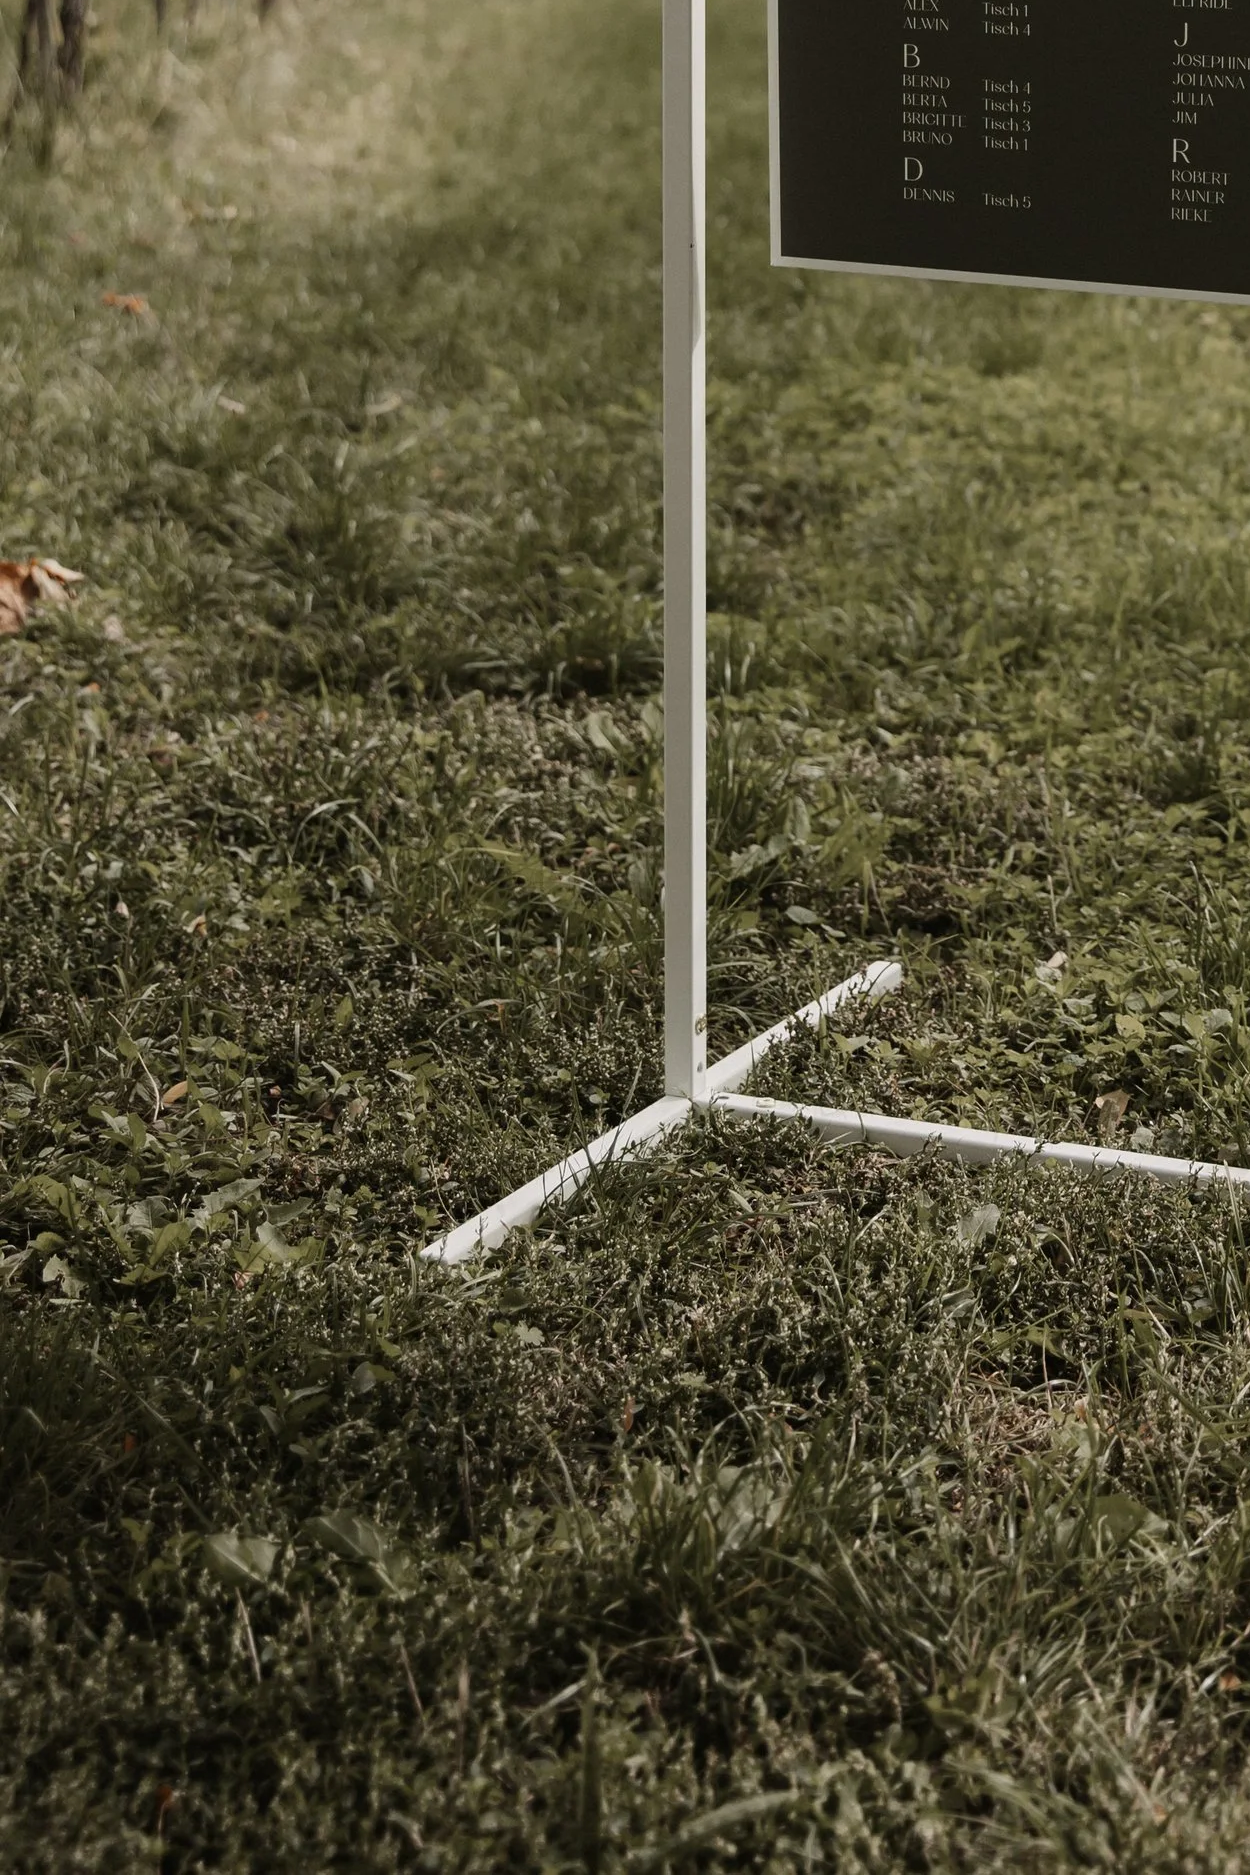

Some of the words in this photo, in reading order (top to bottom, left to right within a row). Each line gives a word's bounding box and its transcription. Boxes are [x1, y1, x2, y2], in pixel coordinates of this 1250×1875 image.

[983, 2, 1019, 16] Tisch
[1023, 5, 1029, 17] 1
[903, 17, 949, 31] ALWIN
[983, 21, 1019, 36] Tisch
[1022, 24, 1031, 36] 4
[1174, 22, 1189, 47] J
[903, 43, 921, 68] B
[903, 74, 950, 89] BERND
[983, 79, 1019, 94] Tisch
[1022, 82, 1031, 94] 4
[1173, 73, 1245, 90] JOHANNA
[903, 93, 947, 108] BERTA
[983, 98, 1019, 113] Tisch
[1022, 101, 1031, 113] 5
[1173, 92, 1214, 107] JULIA
[983, 117, 1019, 131] Tisch
[1022, 120, 1031, 132] 3
[1172, 111, 1197, 125] JIM
[903, 130, 952, 145] BRUNO
[983, 136, 1019, 150] Tisch
[1023, 139, 1029, 150] 1
[1172, 138, 1190, 163] R
[904, 157, 923, 181] D
[1171, 169, 1230, 186] ROBERT
[904, 187, 955, 202] DENNIS
[983, 193, 1019, 207] Tisch
[1022, 196, 1031, 208] 5
[1171, 189, 1224, 204] RAINER
[1171, 208, 1212, 223] RIEKE
